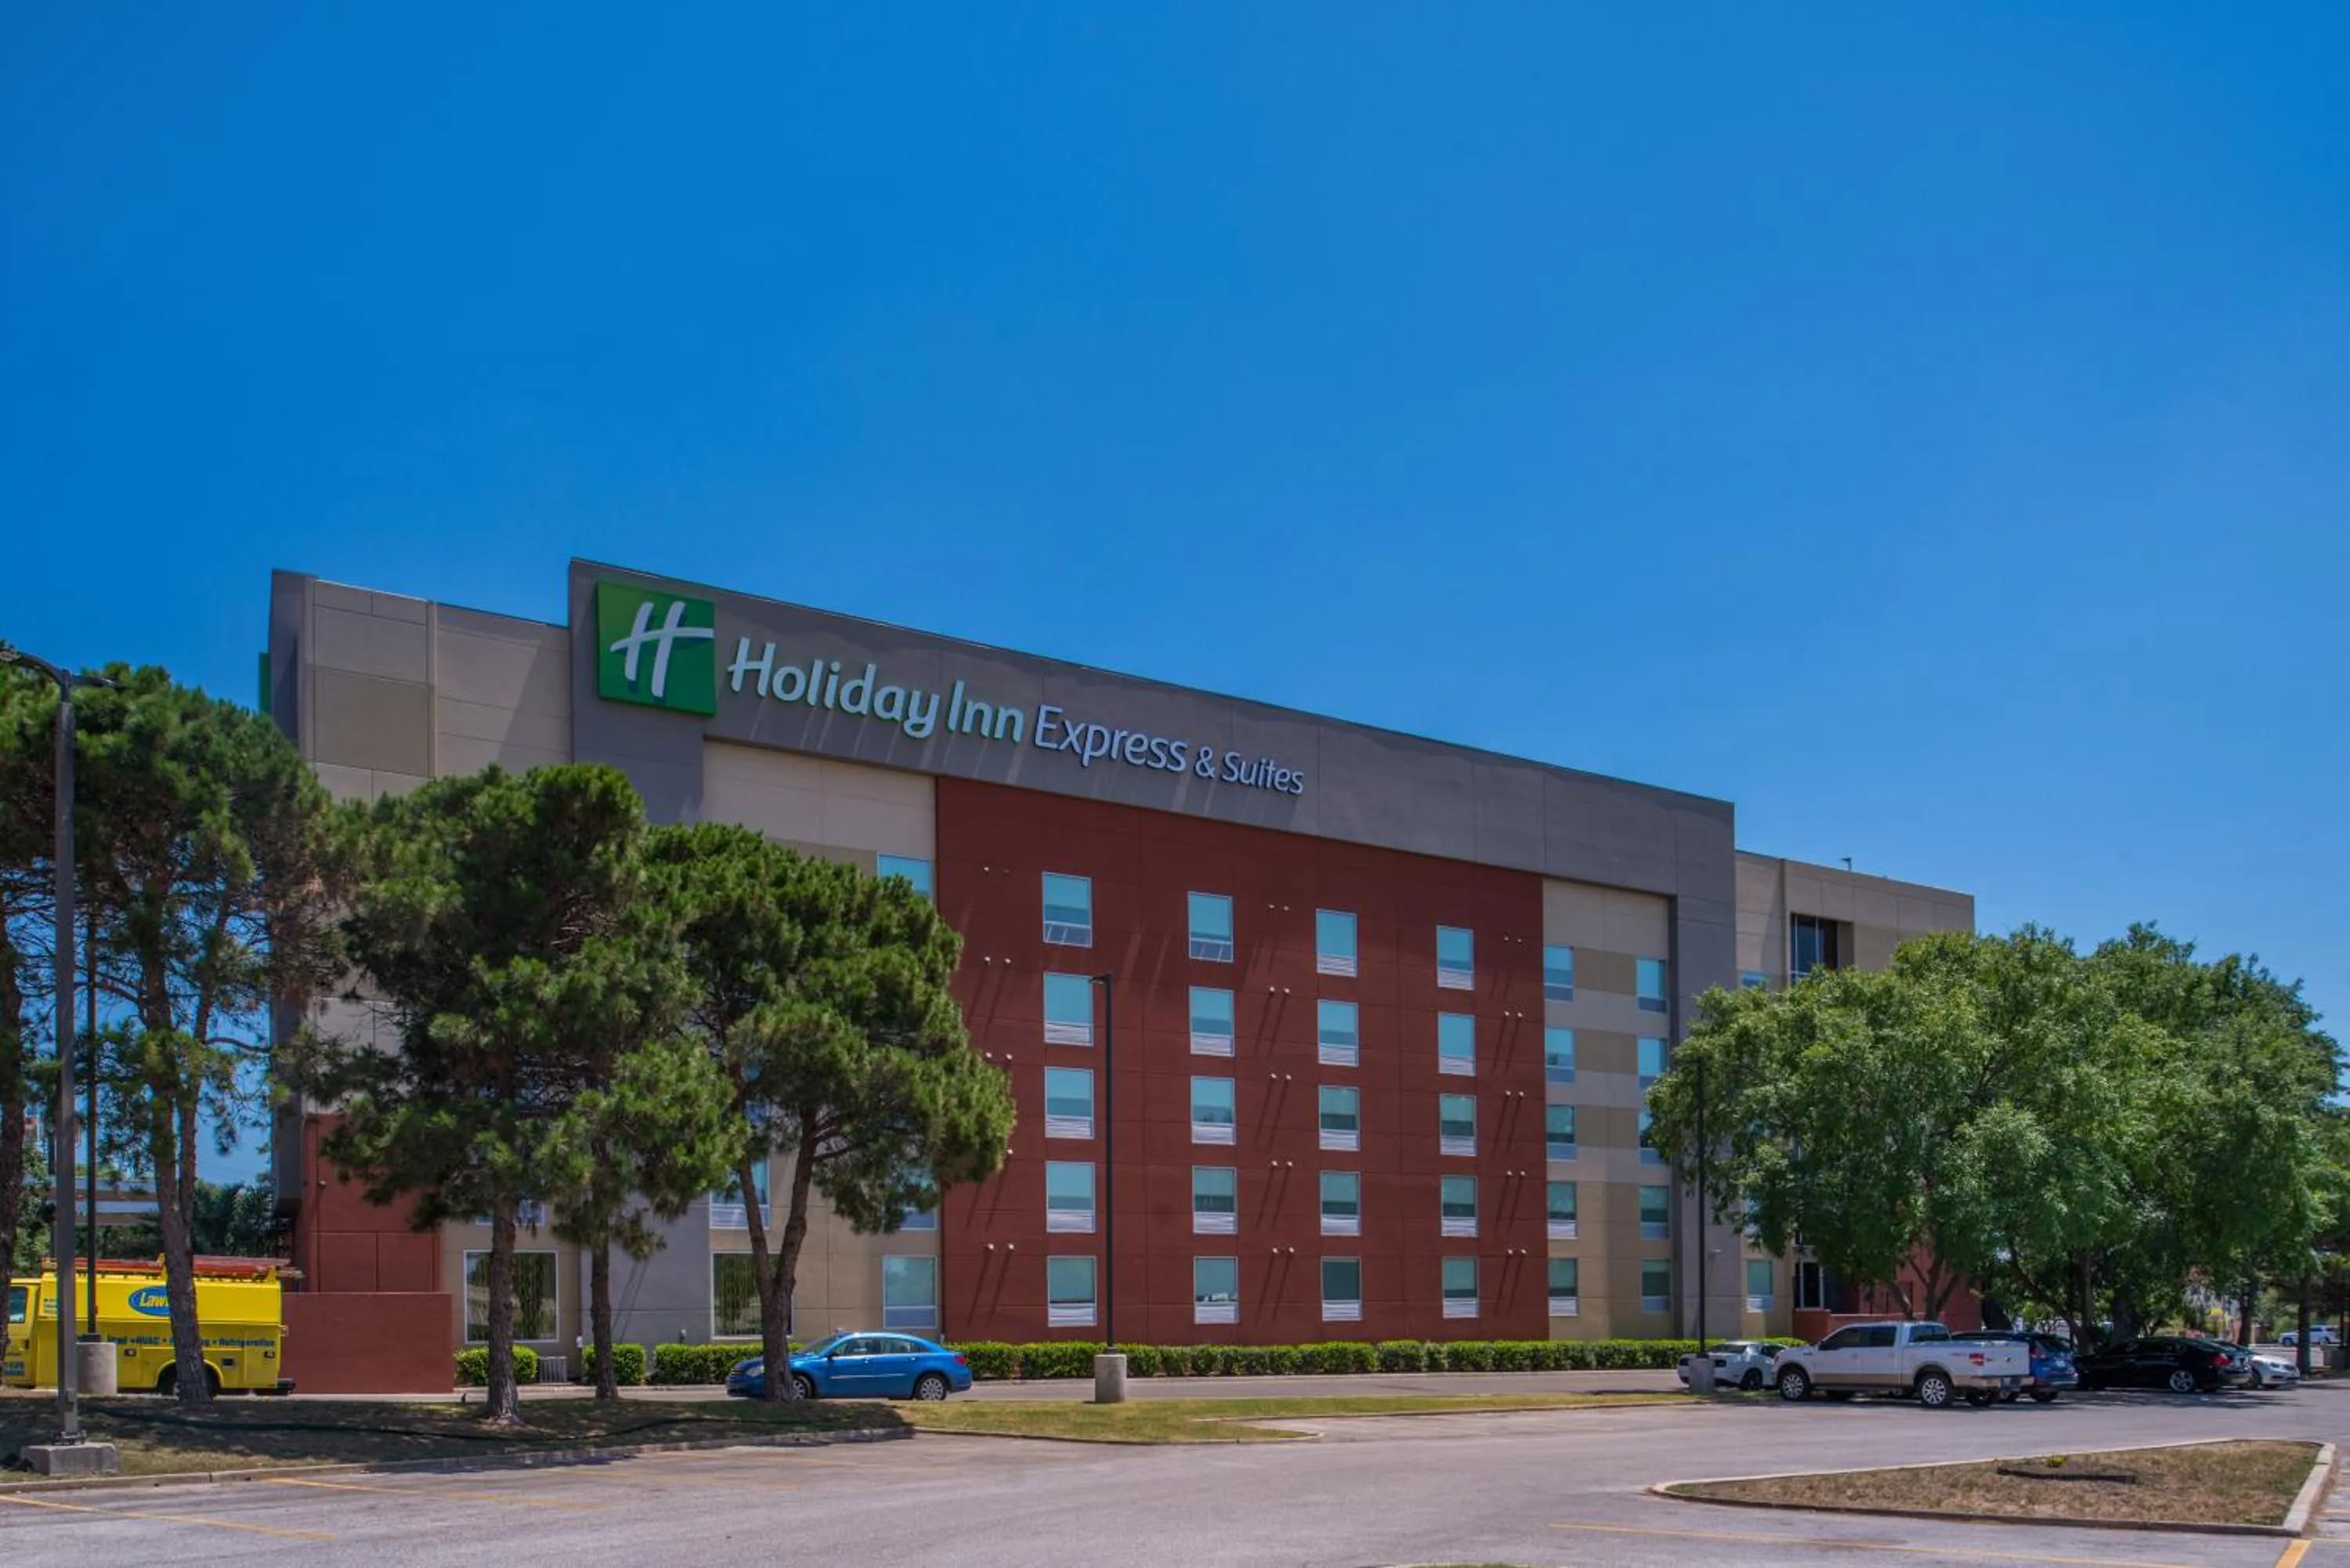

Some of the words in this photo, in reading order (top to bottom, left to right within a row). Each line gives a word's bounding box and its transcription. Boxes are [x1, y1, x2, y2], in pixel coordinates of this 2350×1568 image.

[728, 637, 940, 739] Holiday
[947, 680, 1024, 743] Inn
[1034, 704, 1189, 772] Express
[1195, 746, 1217, 778] &
[1221, 751, 1305, 796] Suites
